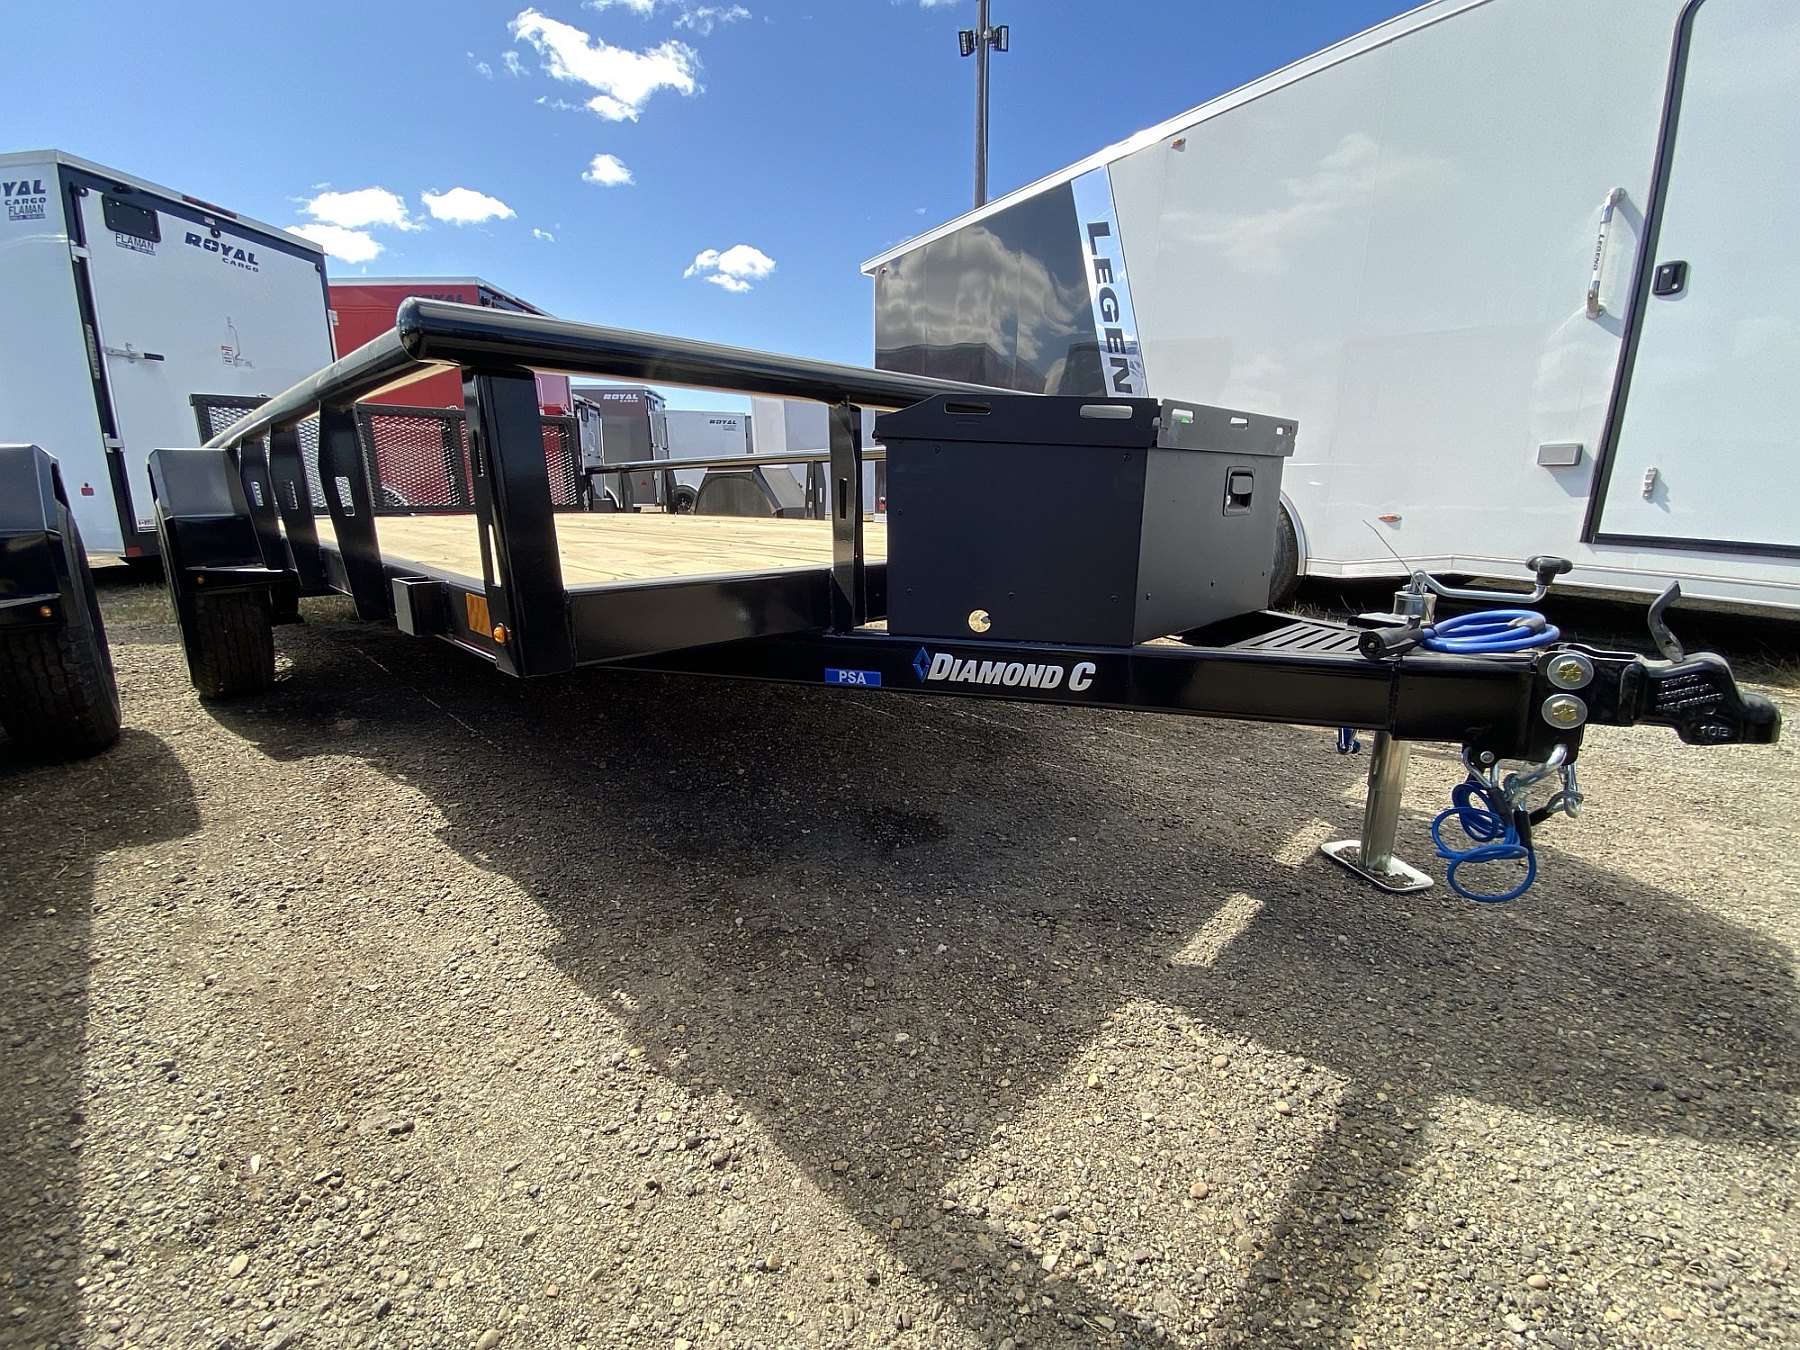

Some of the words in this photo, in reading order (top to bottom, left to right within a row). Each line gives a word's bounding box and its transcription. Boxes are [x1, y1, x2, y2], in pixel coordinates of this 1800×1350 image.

[0, 180, 46, 197] YAL
[4, 197, 46, 206] CARGO
[9, 204, 44, 216] FLAMAN
[115, 232, 154, 251] FLAMAN
[185, 232, 259, 266] ROYAL
[222, 257, 259, 273] CARGO
[1087, 221, 1133, 394] LEGEN
[603, 393, 639, 401] ROYAL
[838, 670, 867, 685] PSA
[927, 652, 1064, 690] DIAMOND
[1068, 661, 1096, 692] C
